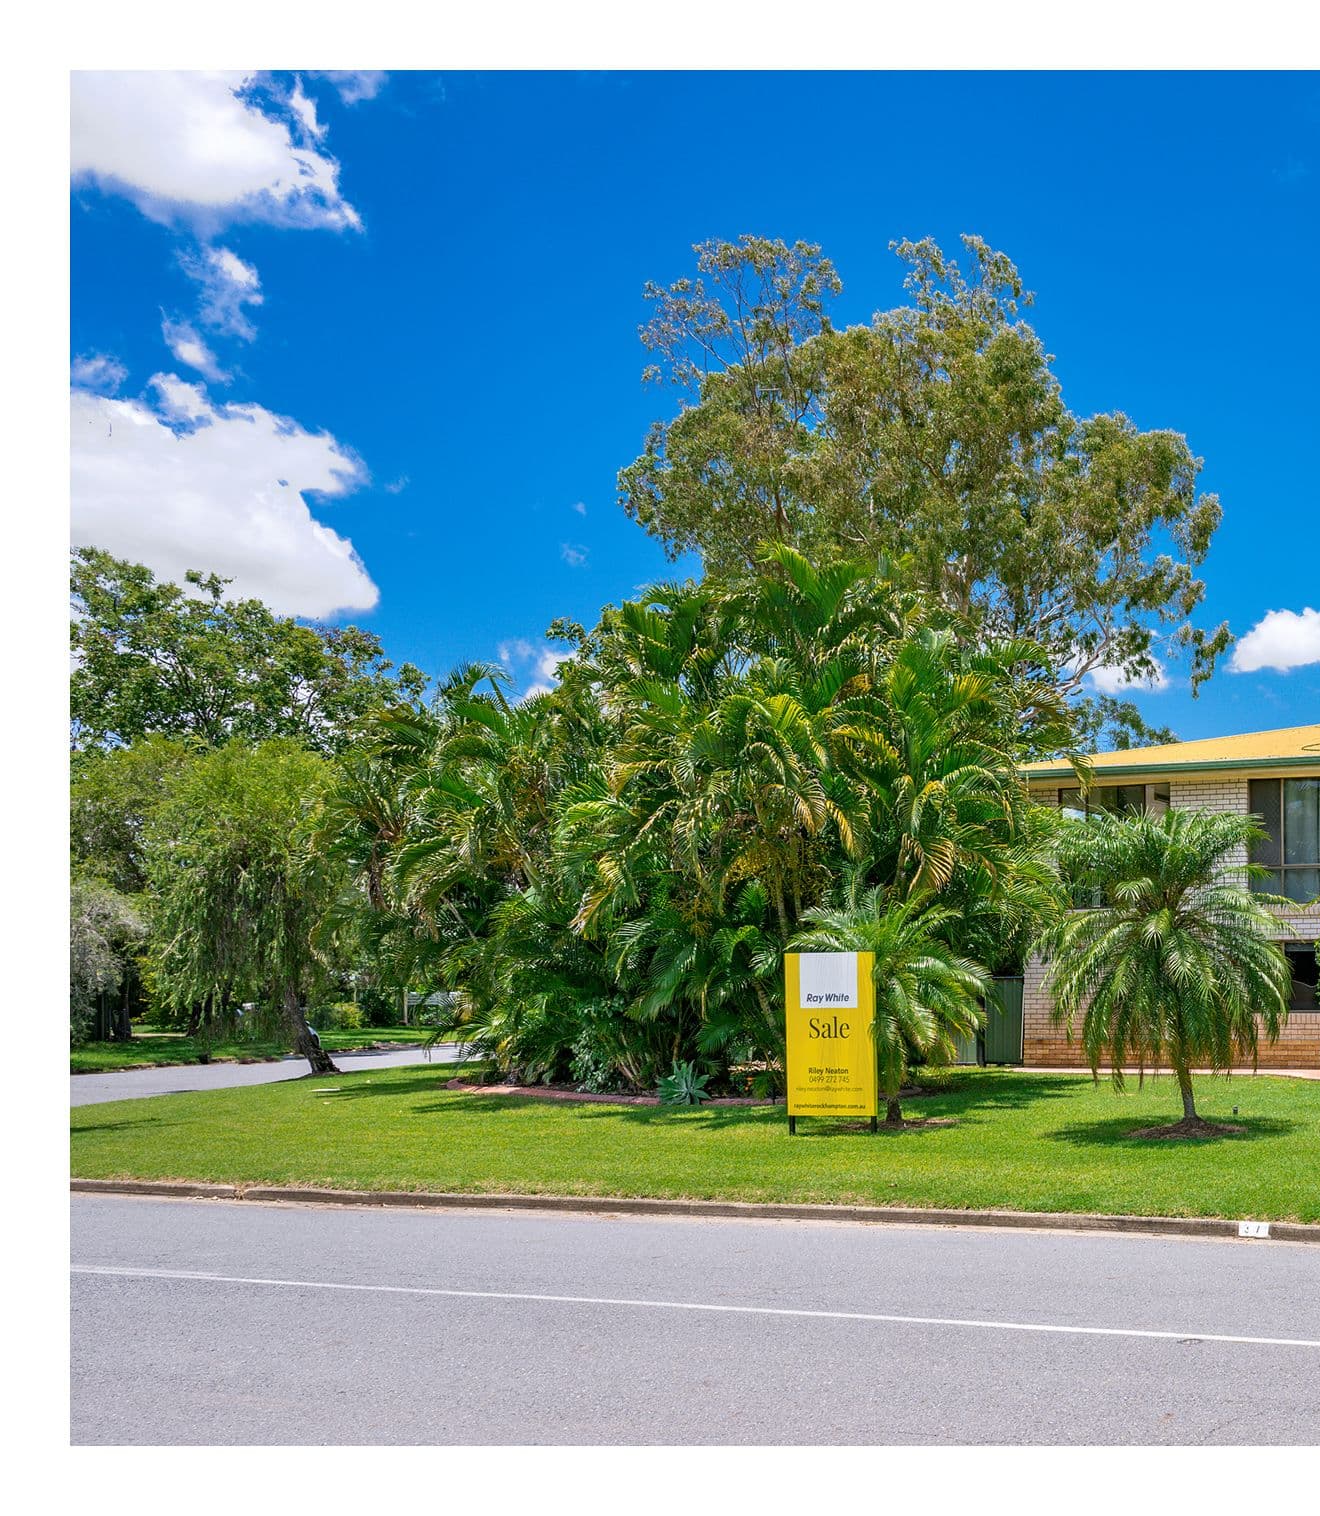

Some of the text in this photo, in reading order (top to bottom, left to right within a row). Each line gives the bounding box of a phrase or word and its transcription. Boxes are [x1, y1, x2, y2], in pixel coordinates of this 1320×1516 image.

[806, 993, 850, 1004] Ray White
[809, 1016, 850, 1039] Sale
[808, 1067, 824, 1075] Riley
